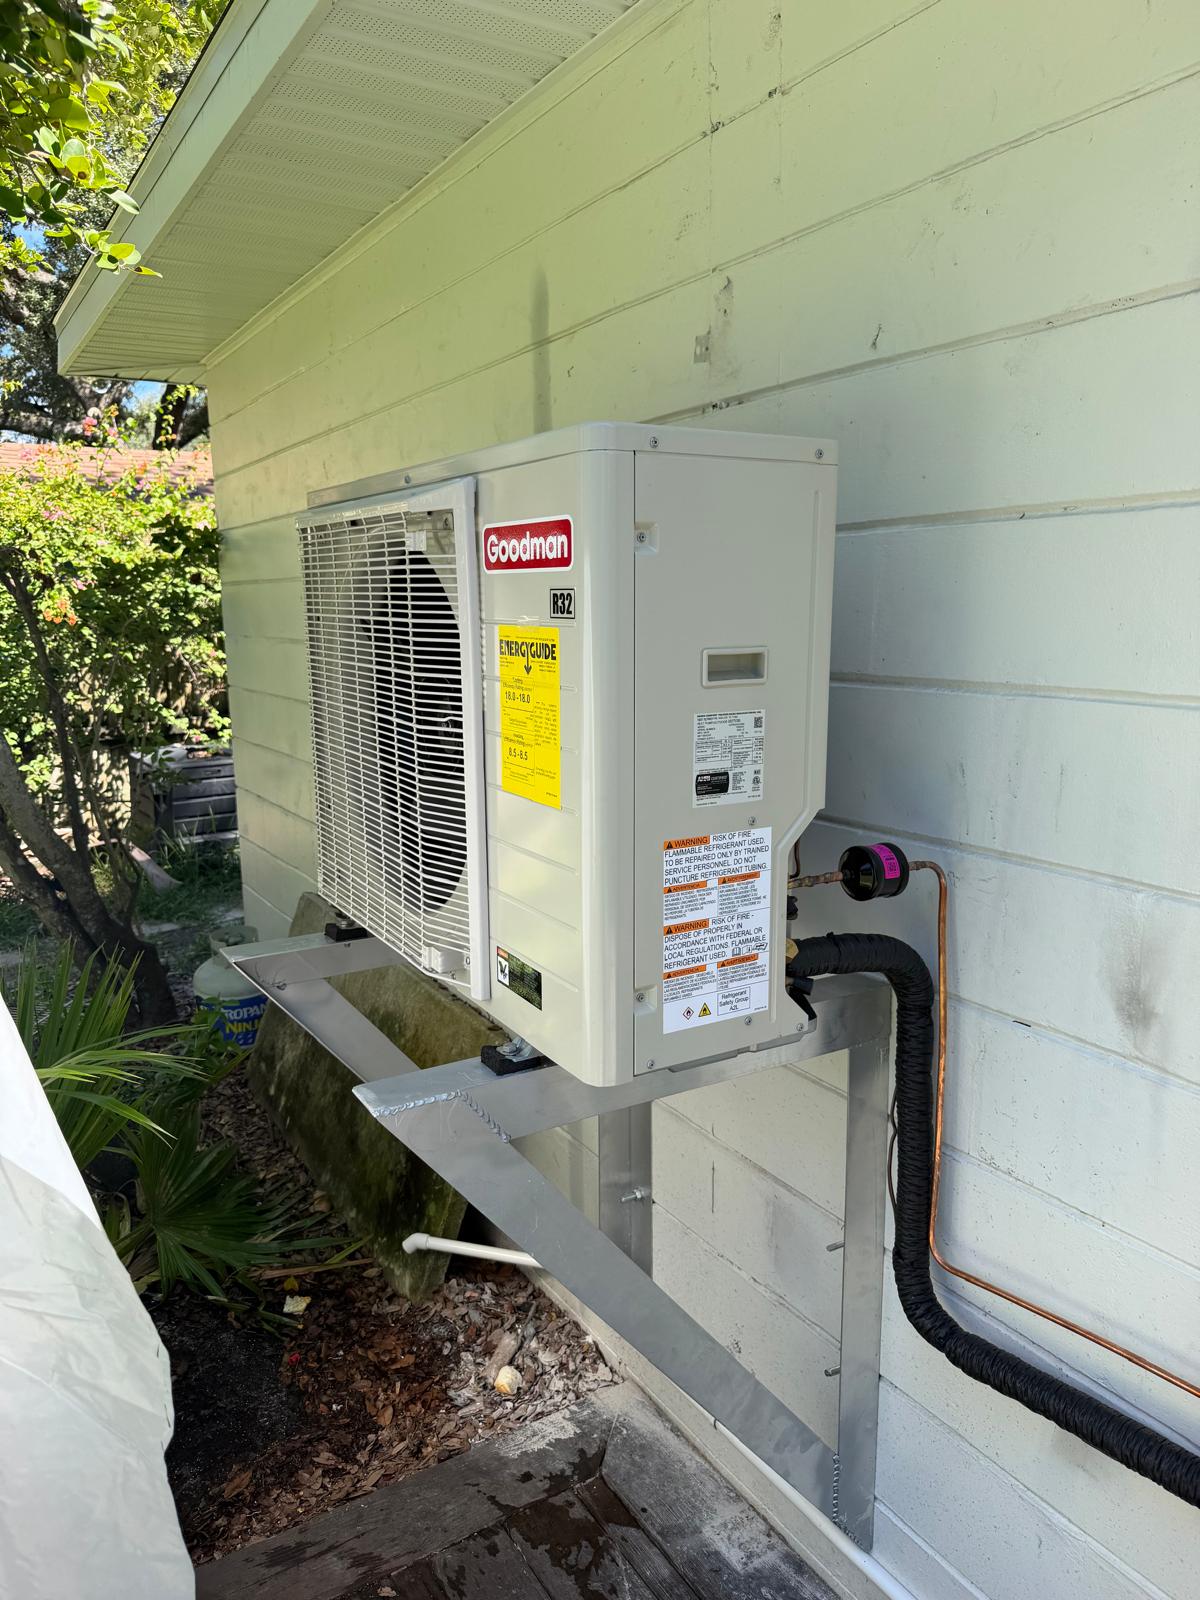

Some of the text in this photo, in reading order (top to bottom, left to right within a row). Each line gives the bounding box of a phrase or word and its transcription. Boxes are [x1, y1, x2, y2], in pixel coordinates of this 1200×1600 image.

[487, 531, 568, 563] Goodman
[552, 593, 572, 615] R32
[675, 836, 708, 847] WARNING
[713, 834, 727, 842] RISK
[738, 831, 752, 839] FIRE
[665, 837, 765, 858] FLAMMABLE REFRIGERANT USED.
[665, 859, 674, 867] TO
[685, 853, 716, 864] REPAIRED
[717, 850, 733, 859] ONLY
[743, 845, 769, 855] TRAINED
[665, 866, 691, 876] SERVICE
[694, 860, 732, 873] PERSONNEL.
[744, 856, 756, 864] NOT
[665, 874, 699, 886] PUNCTURE
[701, 867, 743, 879] REFRIGERANT
[665, 933, 691, 943] DISPOSE
[704, 925, 735, 935] PROPERLY
[674, 921, 707, 932] WARNING
[664, 938, 707, 951] ACCORDANCE
[709, 934, 724, 942] WITH
[726, 929, 752, 940] FEDERAL
[665, 952, 684, 961] LOCAL
[731, 935, 766, 947] FLAMMABLE
[664, 951, 727, 970] REFRIGERANT USED.
[719, 996, 749, 1007] Safety Group
[722, 990, 747, 999] Refrigerant
[225, 1020, 260, 1034] NINJ
